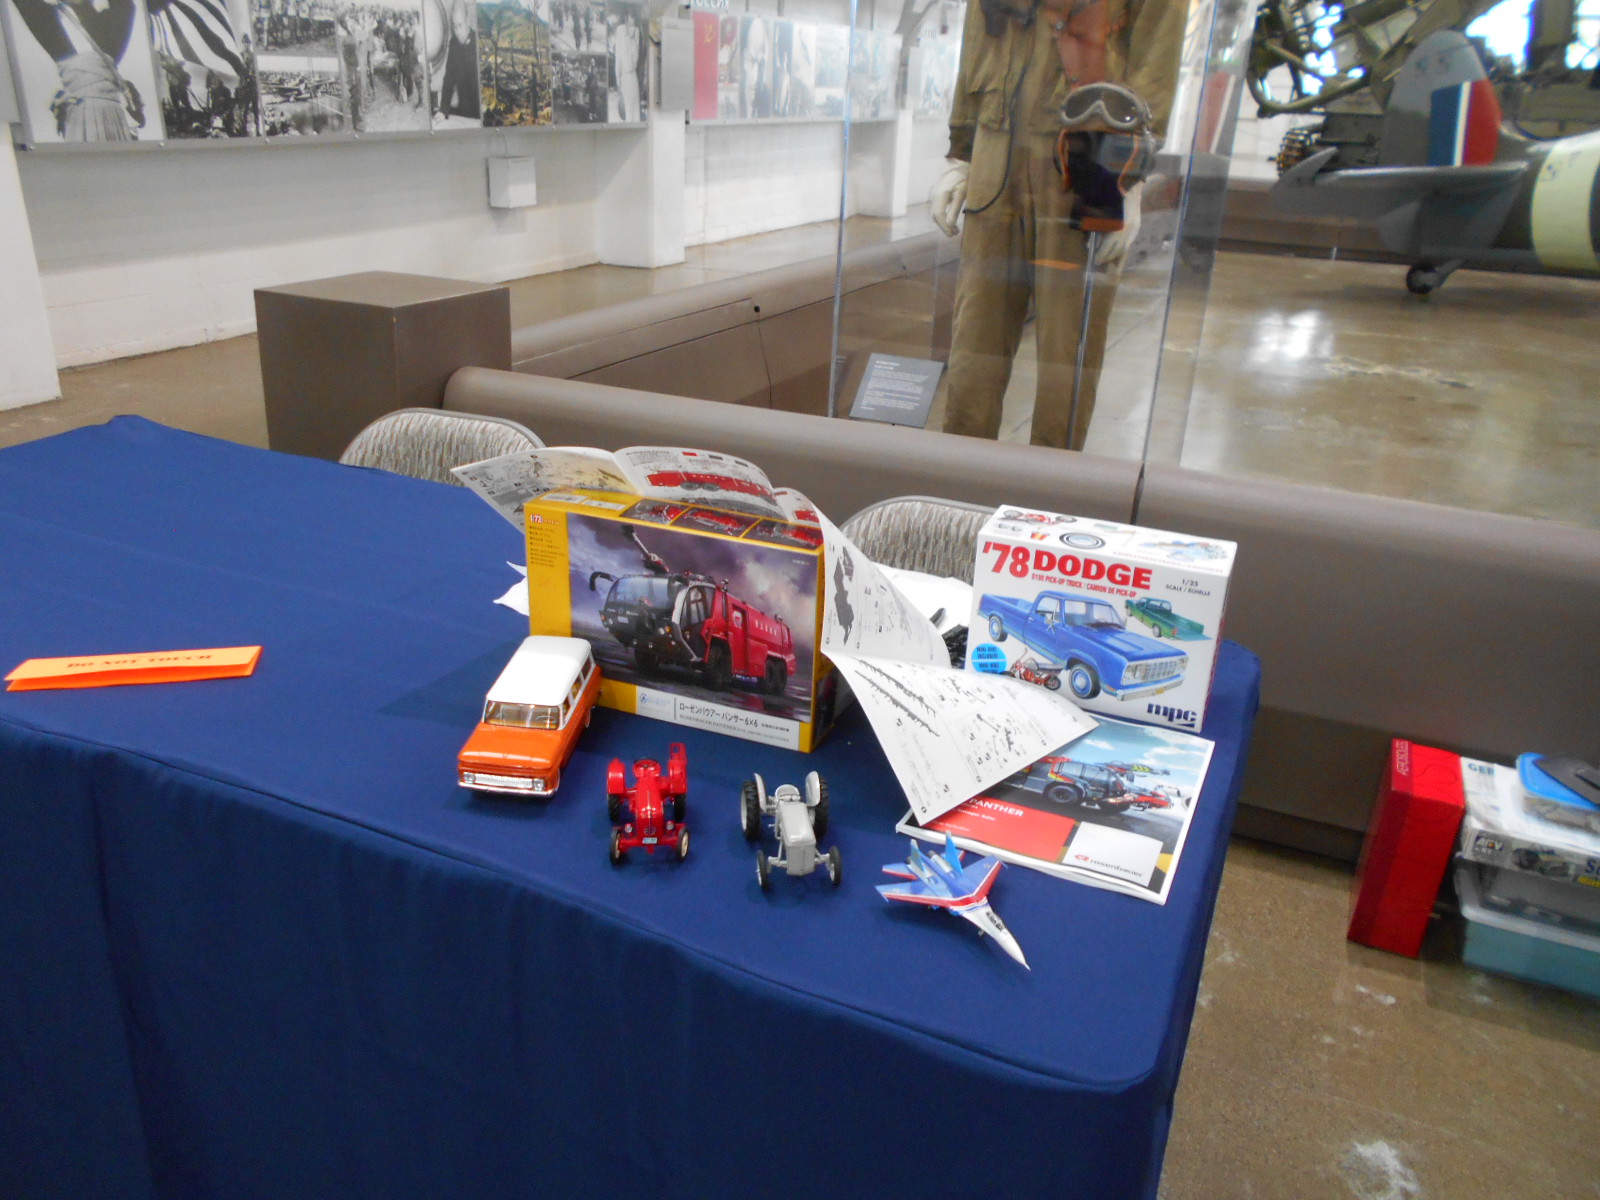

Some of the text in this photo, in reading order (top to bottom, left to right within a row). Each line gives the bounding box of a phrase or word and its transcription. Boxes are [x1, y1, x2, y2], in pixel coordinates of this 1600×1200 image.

[982, 541, 1030, 578] '78
[1033, 549, 1152, 590] DODGE
[1045, 574, 1065, 584] PICK-UP
[1066, 578, 1082, 588] TRUCK
[1166, 584, 1181, 592] SCALE
[1182, 579, 1198, 587] 1/25
[147, 654, 212, 662] TOUCH
[1147, 703, 1198, 727] mpc
[969, 798, 1025, 817] PANTHER
